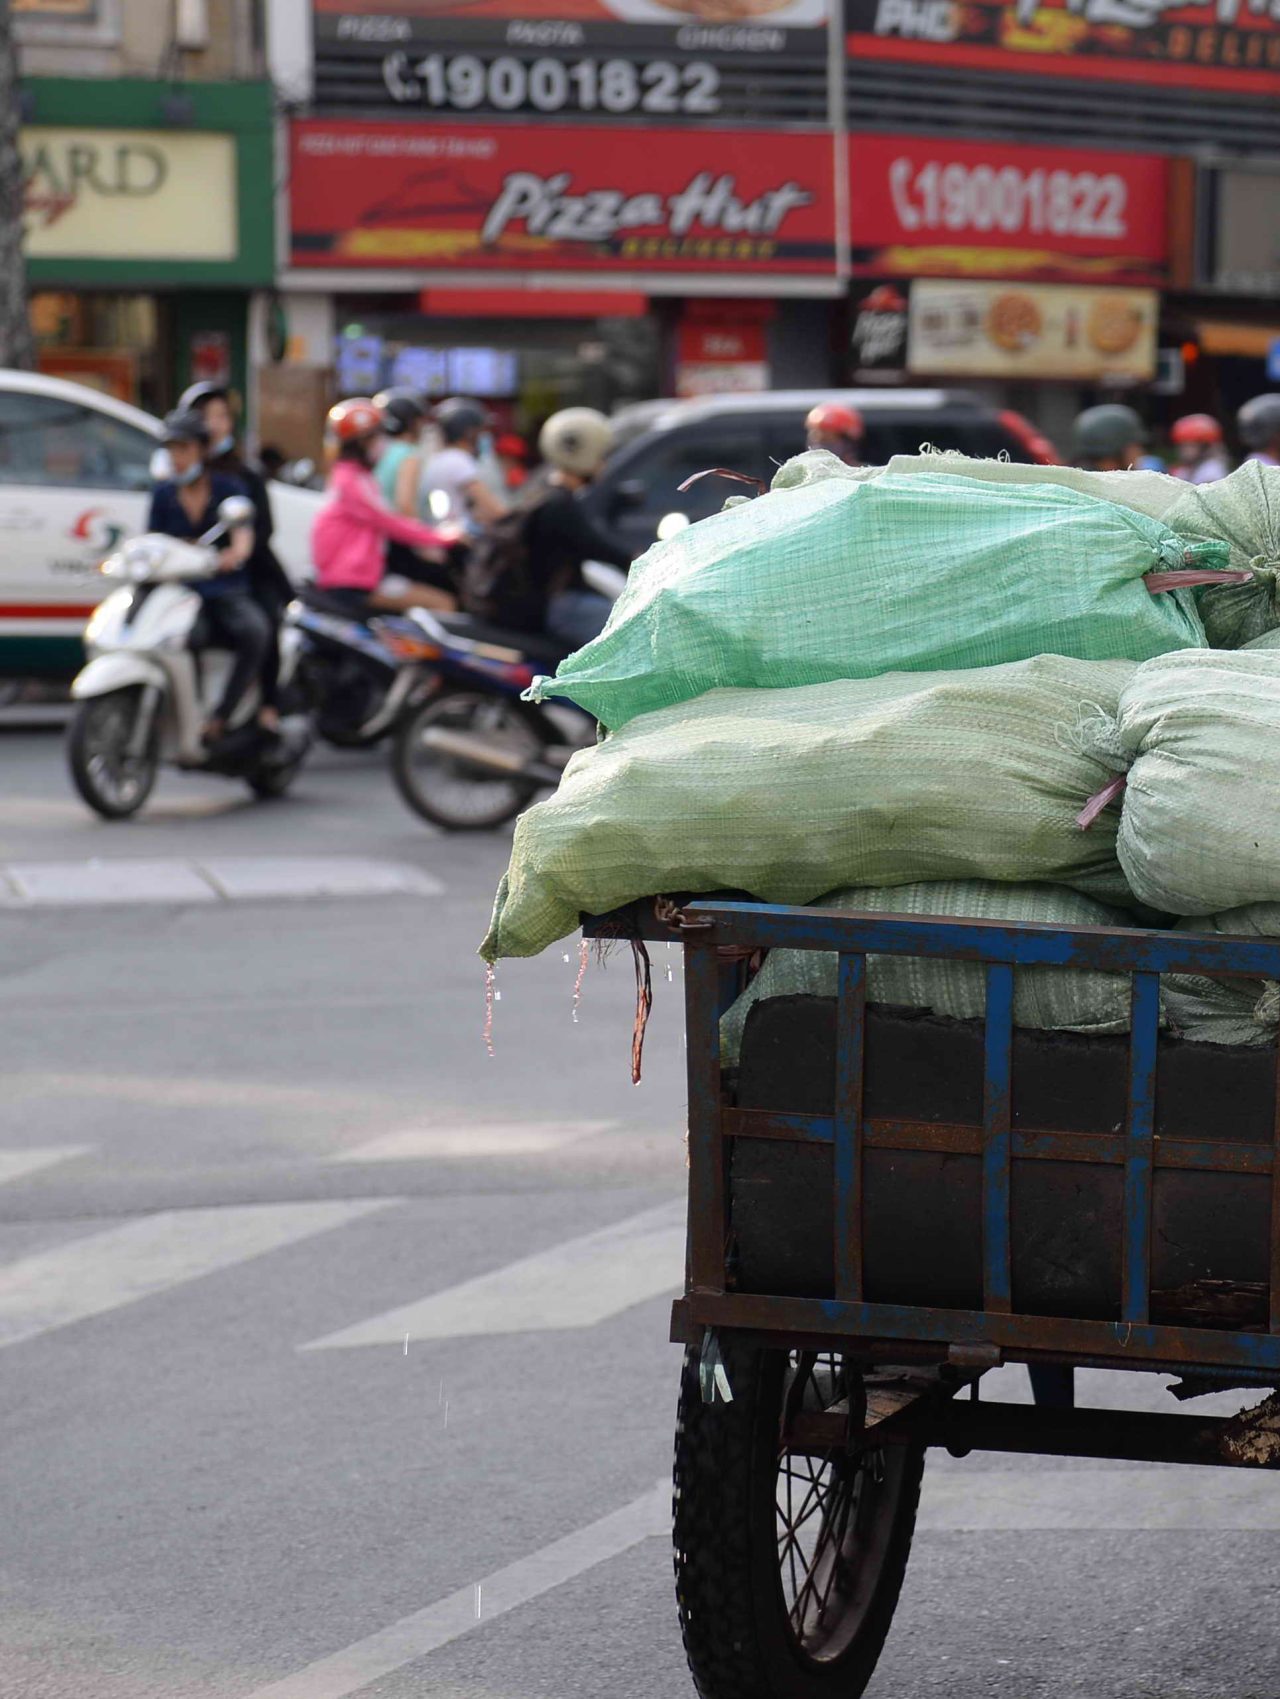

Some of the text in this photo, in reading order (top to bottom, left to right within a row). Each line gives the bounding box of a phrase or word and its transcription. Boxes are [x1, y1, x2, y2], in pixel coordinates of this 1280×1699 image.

[505, 19, 584, 47] PASTA
[676, 25, 787, 52] CHICKEN
[416, 53, 720, 112] 19001822
[481, 172, 814, 245] Pizza Hut
[914, 160, 1128, 239] 19001822
